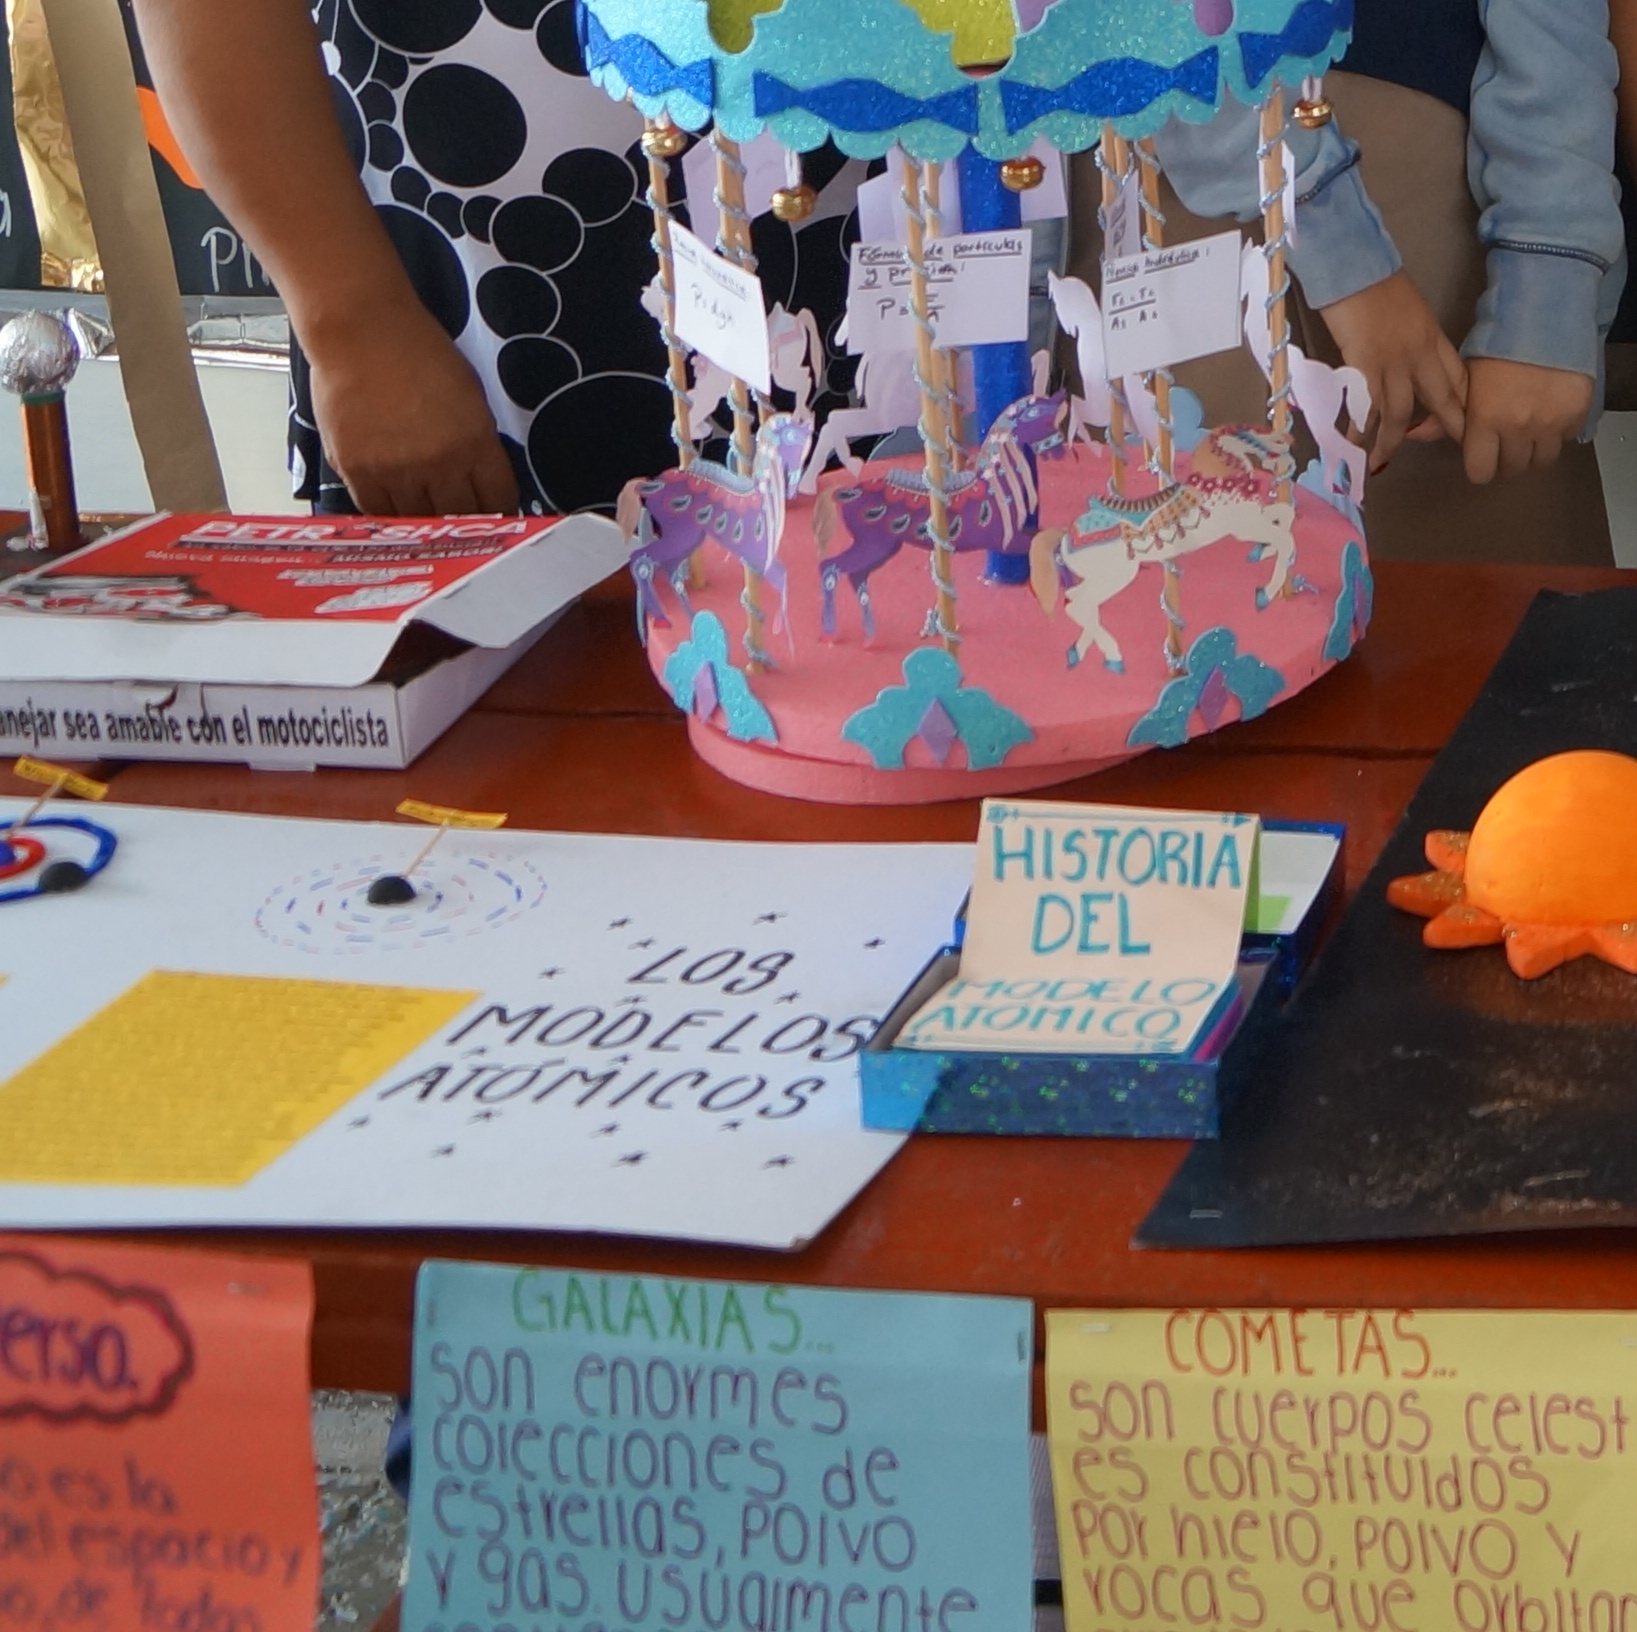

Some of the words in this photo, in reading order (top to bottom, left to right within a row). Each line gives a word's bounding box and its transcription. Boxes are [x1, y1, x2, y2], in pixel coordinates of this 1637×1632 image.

[62, 710, 100, 740] sea
[104, 699, 182, 743] amable
[186, 712, 228, 745] con
[231, 705, 252, 746] el
[256, 705, 390, 747] motociclista
[992, 824, 1243, 889] HISTORIA
[1030, 891, 1151, 956] DEL
[625, 944, 796, 996] LOS
[946, 976, 1217, 1007] MODELO
[445, 1002, 880, 1062] MODELOS
[573, 1350, 850, 1436] enormes
[1212, 1385, 1434, 1454] cuerpos
[431, 1412, 787, 1502] colecciones
[822, 1445, 900, 1512] de
[1071, 1445, 1151, 1504] es
[1183, 1446, 1551, 1516] constituidos
[426, 1549, 456, 1611] y
[1545, 1523, 1581, 1578] y
[1086, 1564, 1269, 1628] rocas
[1301, 1571, 1418, 1632] que
